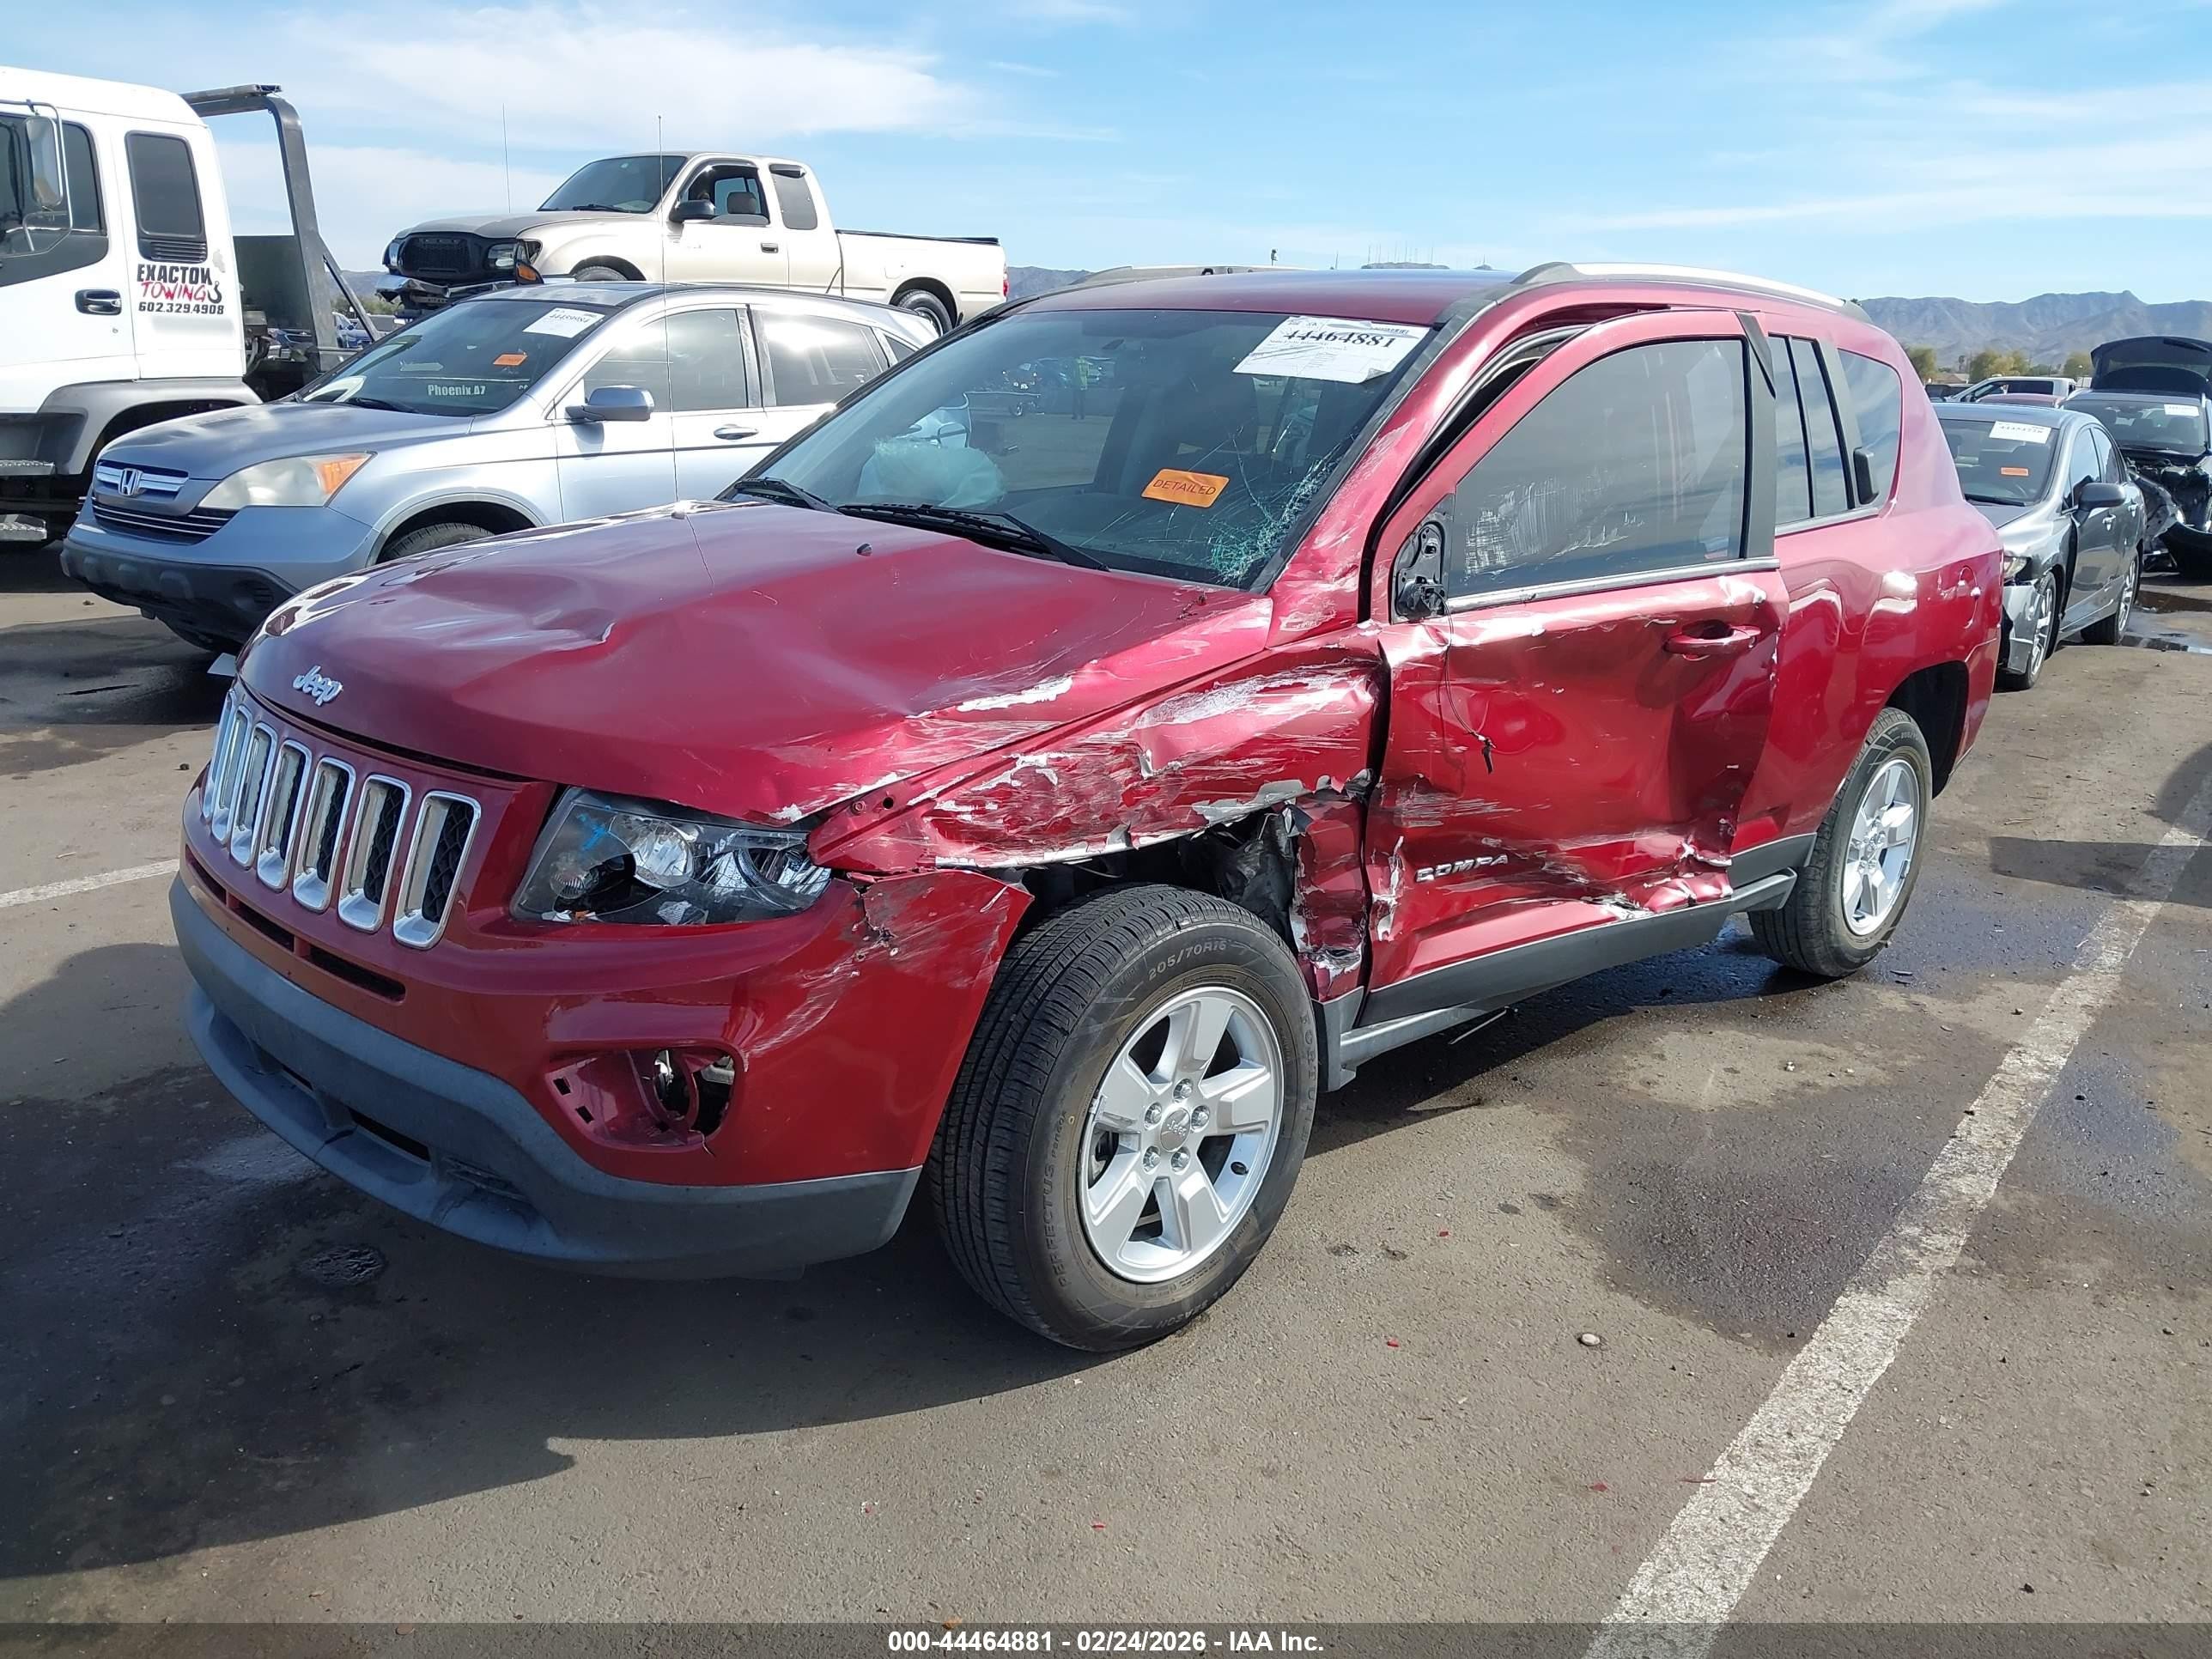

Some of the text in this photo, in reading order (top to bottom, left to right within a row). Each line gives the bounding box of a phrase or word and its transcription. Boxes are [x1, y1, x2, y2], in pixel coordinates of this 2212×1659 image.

[142, 282, 206, 302] TOWING
[138, 301, 224, 314] 602.329.4908
[1283, 329, 1395, 349] 44464881
[1152, 479, 1217, 495] DETAILED
[293, 665, 343, 706] Jeep
[1148, 940, 1227, 981] 205/70R16
[1042, 1164, 1072, 1287] PERFECTUS
